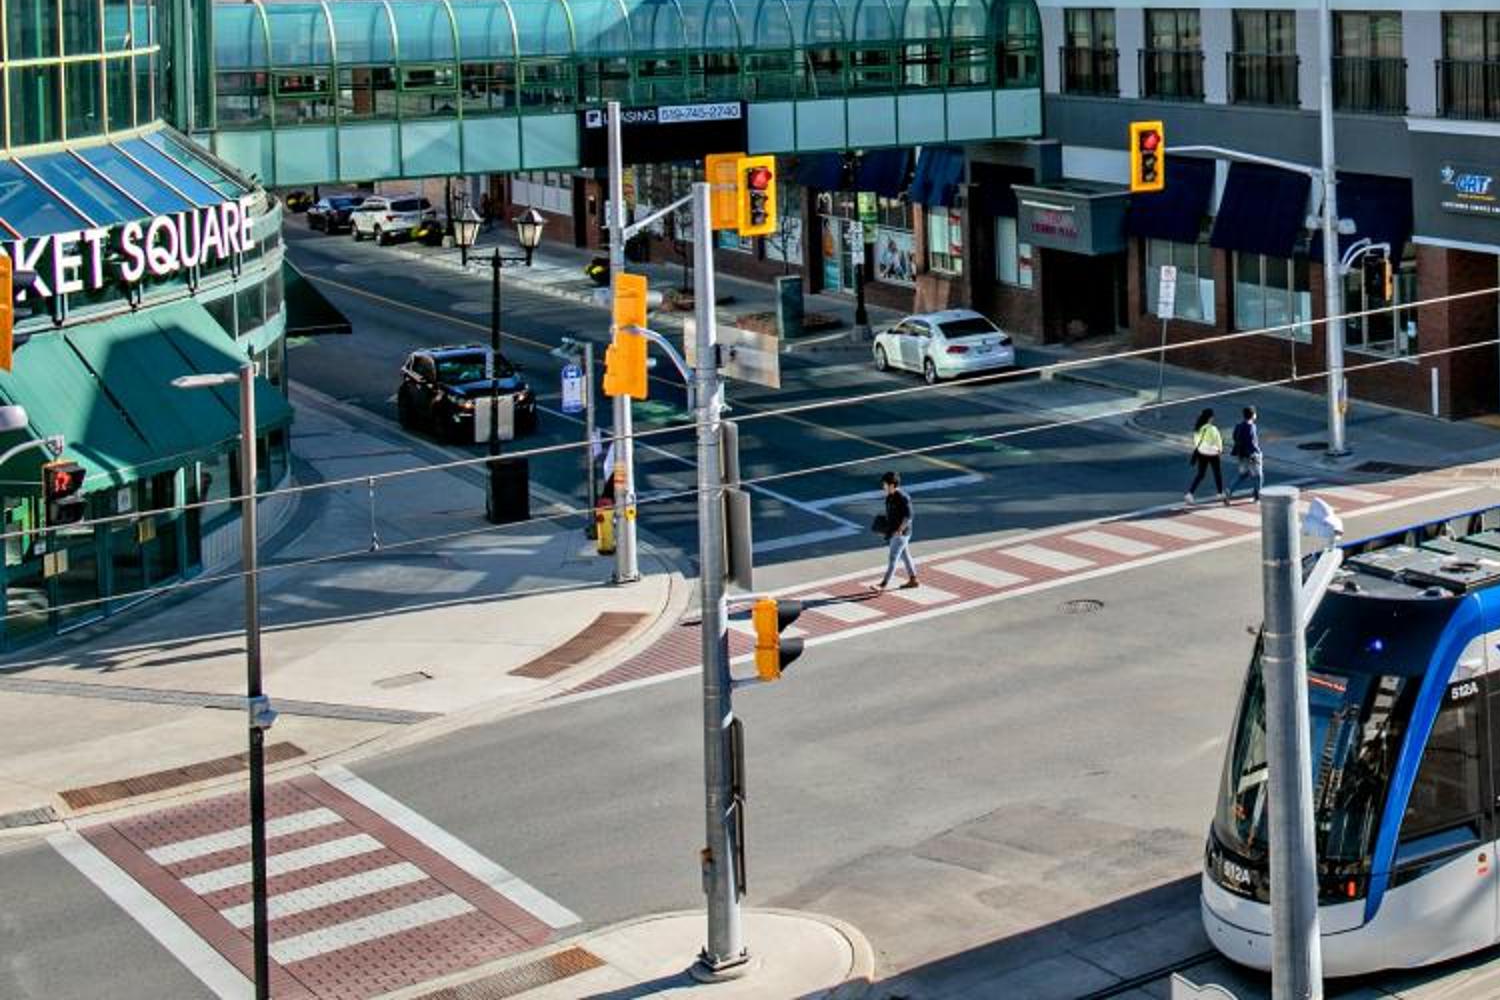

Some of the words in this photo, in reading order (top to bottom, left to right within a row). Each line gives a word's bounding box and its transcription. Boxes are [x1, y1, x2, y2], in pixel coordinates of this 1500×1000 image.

[603, 109, 657, 125] LSING
[1456, 174, 1494, 195] GRT
[3, 225, 108, 301] KET
[121, 196, 256, 283] SQUARE
[1450, 680, 1480, 701] 512A
